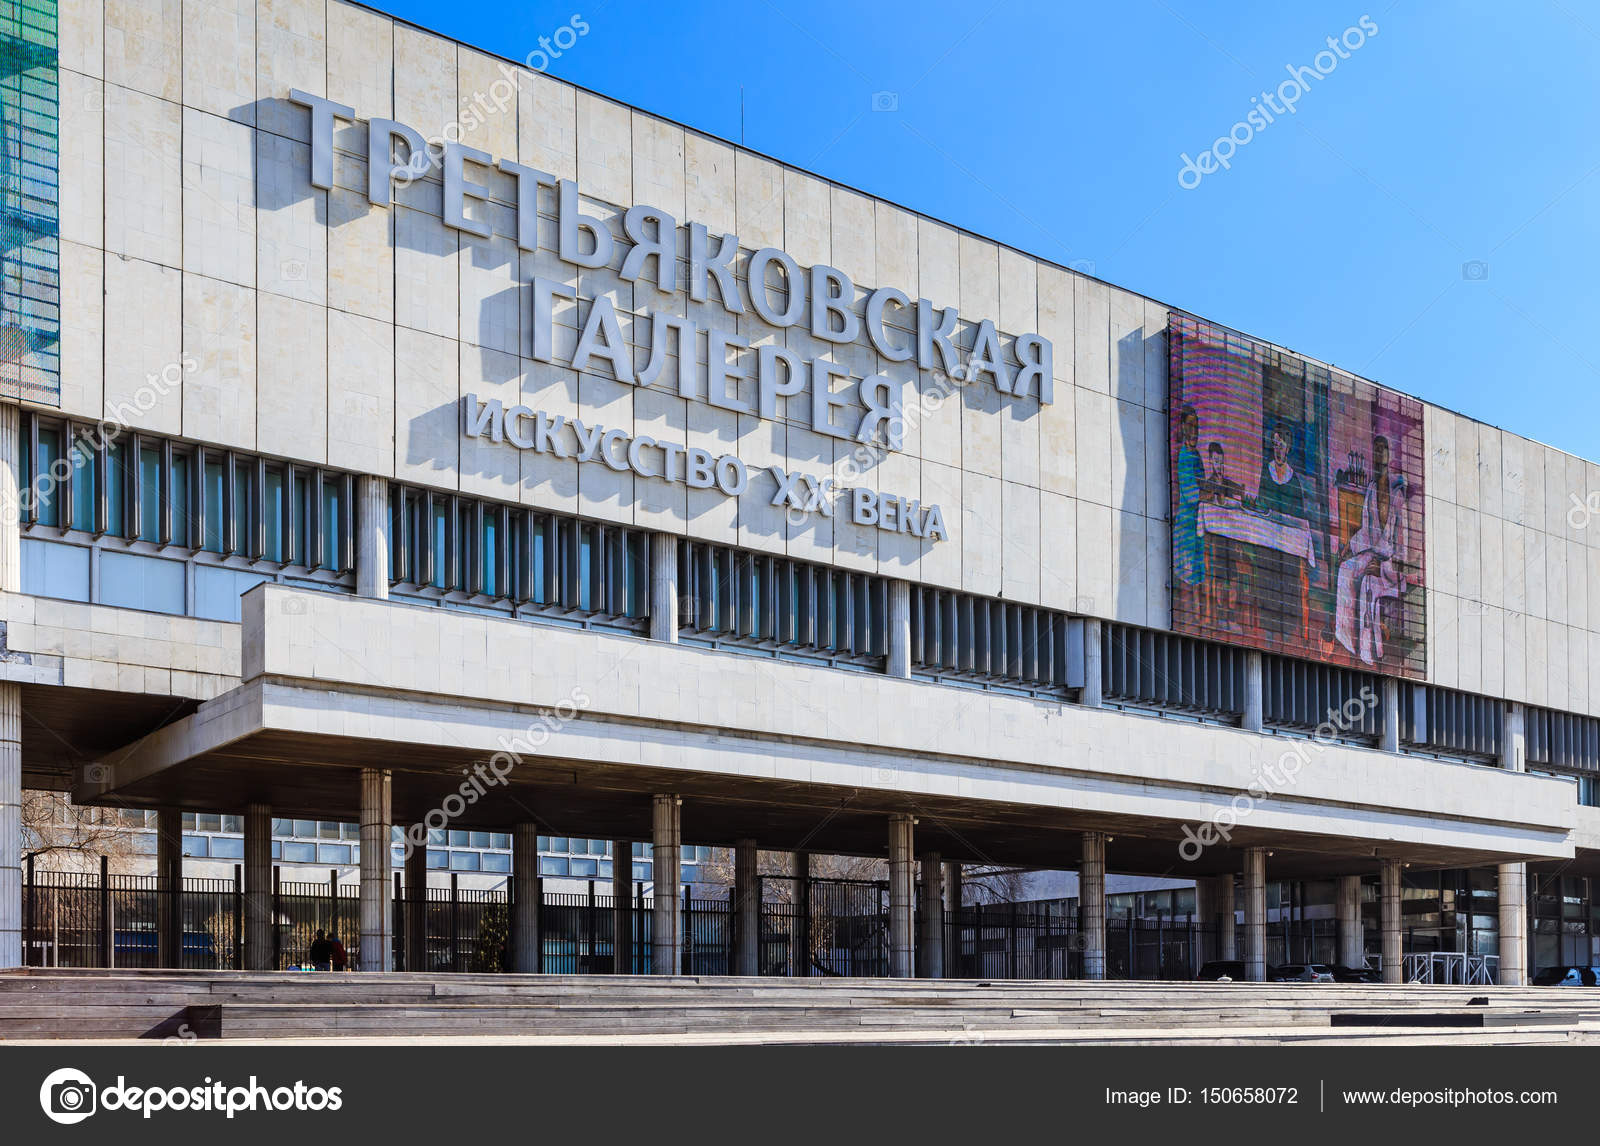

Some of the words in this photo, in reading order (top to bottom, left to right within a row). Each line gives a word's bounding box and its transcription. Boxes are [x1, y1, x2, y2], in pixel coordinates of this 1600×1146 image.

[288, 88, 1054, 405] ТРЕТЬЯКОВСКАЯ
[532, 276, 904, 451] ГАЛЕРЕЯ
[464, 392, 748, 498] ИСКУССТВО
[852, 486, 949, 542] ВЕКА
